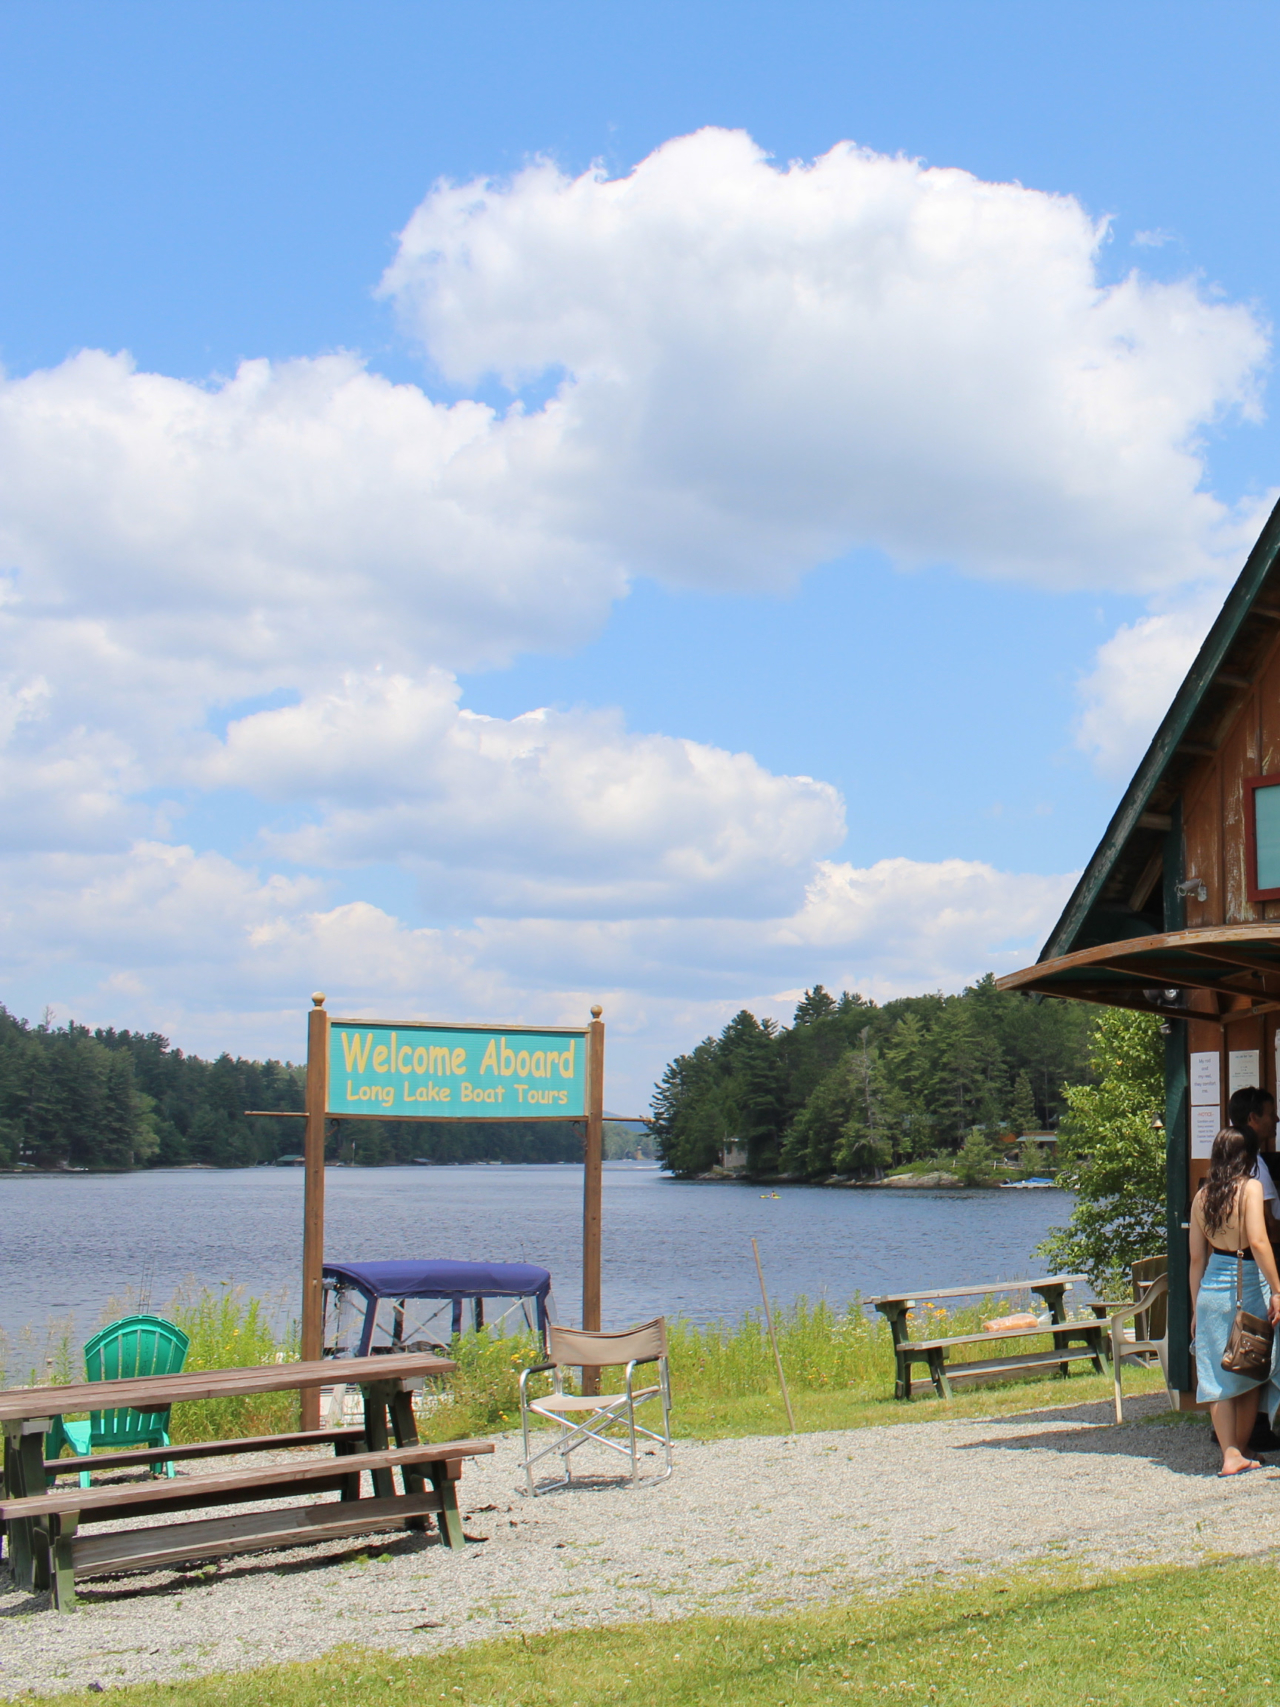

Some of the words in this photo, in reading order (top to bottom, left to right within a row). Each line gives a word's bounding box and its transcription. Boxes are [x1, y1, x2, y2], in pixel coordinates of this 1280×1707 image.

[341, 1031, 467, 1076] Welcome
[480, 1037, 575, 1079] Aboard
[346, 1080, 395, 1107] Long
[403, 1081, 451, 1102] Lake
[460, 1082, 505, 1103] Boat
[514, 1084, 568, 1104] Tours
